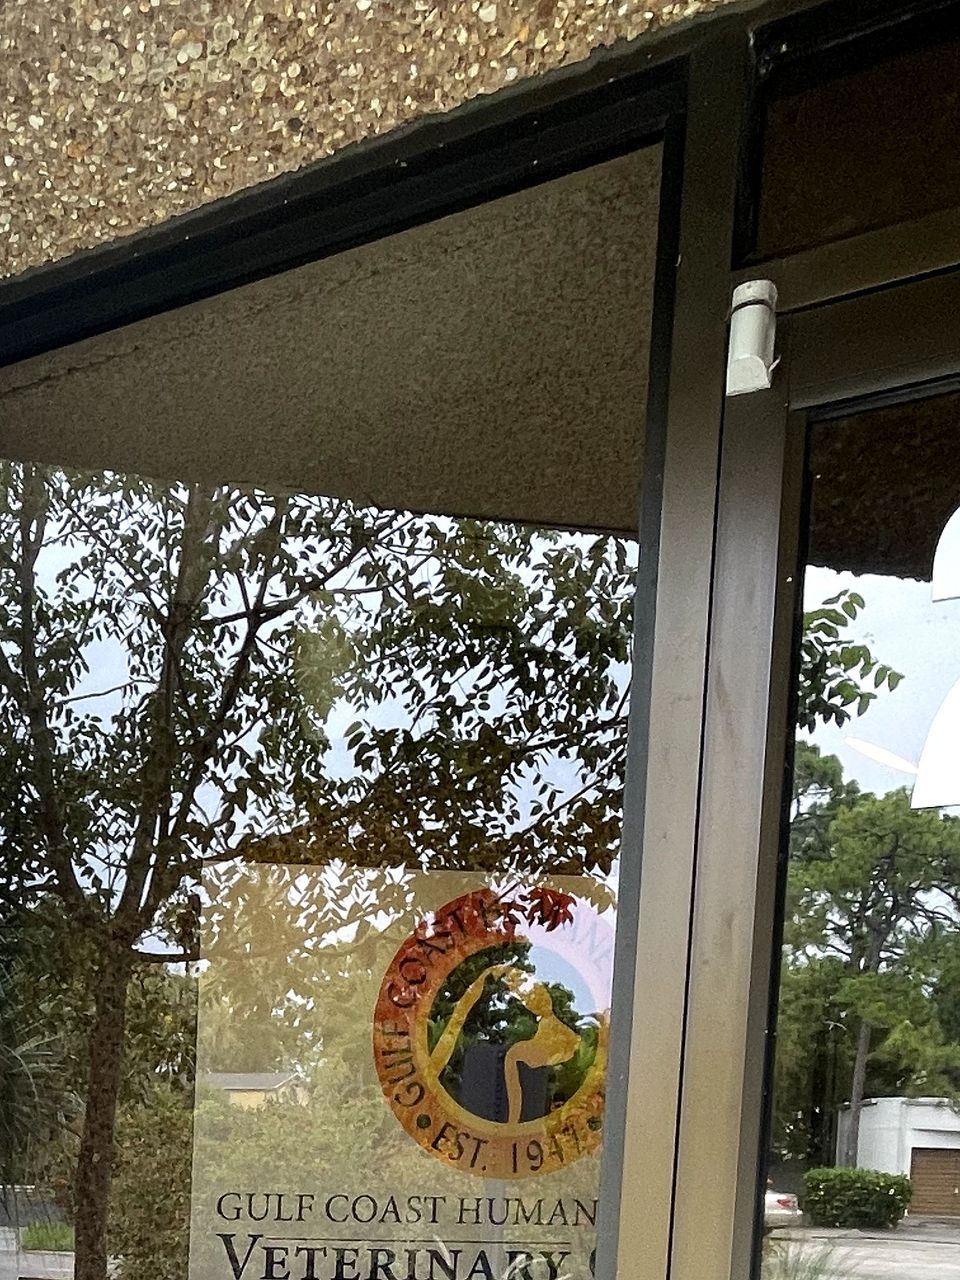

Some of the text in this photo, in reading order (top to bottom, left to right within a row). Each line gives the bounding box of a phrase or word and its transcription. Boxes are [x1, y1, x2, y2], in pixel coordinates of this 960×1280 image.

[381, 908, 467, 1108] GULF COAST
[431, 1121, 489, 1171] EST.
[216, 1192, 600, 1227] GULF COAST HUMAN
